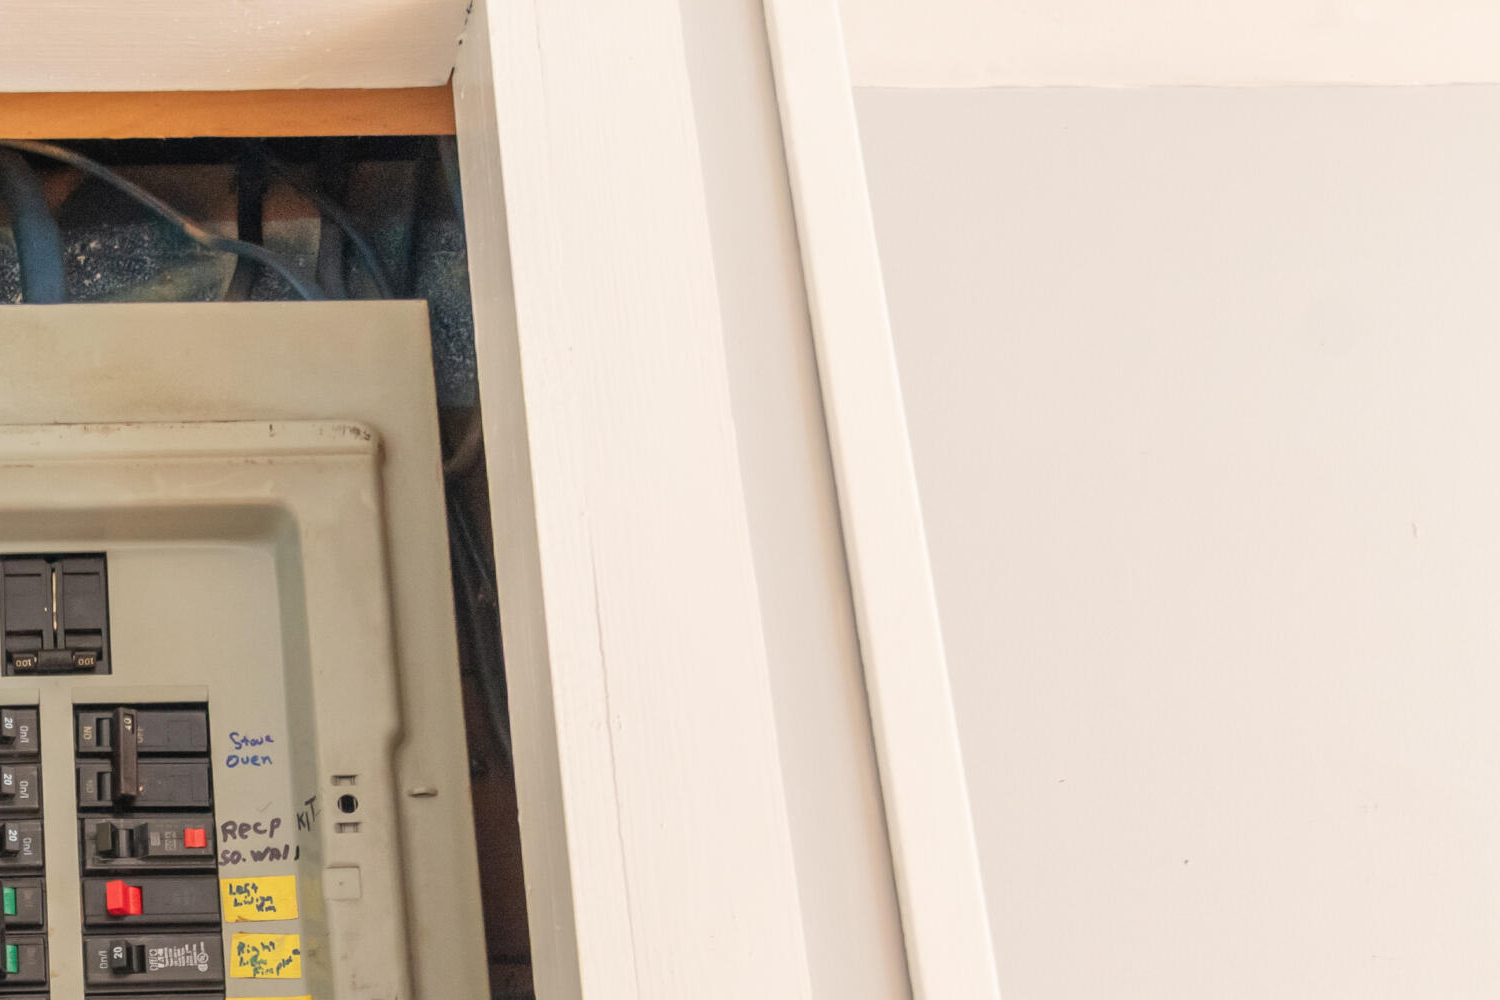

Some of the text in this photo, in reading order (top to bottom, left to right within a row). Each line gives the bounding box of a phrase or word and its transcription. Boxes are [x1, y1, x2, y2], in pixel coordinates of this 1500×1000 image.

[4, 717, 14, 729] 20
[83, 726, 93, 740] ON
[3, 773, 13, 786] 20
[8, 829, 18, 842] 20
[113, 946, 123, 960] 20
